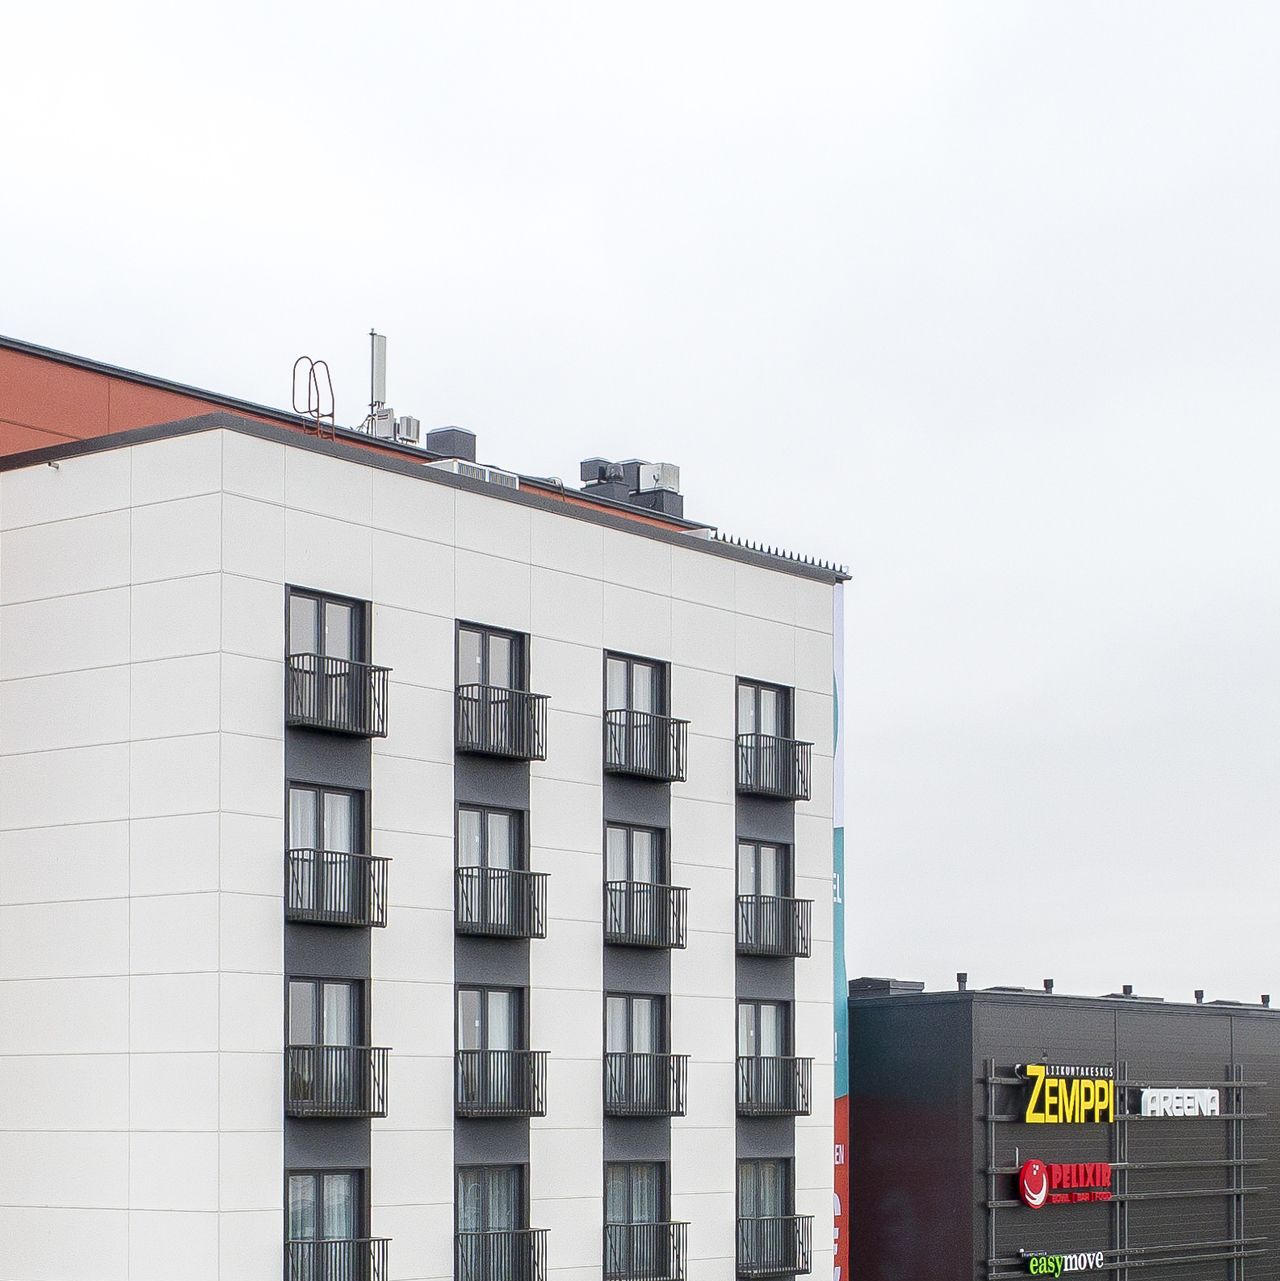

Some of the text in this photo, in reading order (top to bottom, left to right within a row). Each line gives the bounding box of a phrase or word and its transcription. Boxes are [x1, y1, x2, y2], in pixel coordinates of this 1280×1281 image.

[1045, 1065, 1114, 1077] LIIKUNTAKESKUS
[1026, 1065, 1114, 1123] ZEMPPI
[1141, 1088, 1219, 1117] AREENA
[1051, 1163, 1112, 1189] PELIXIR
